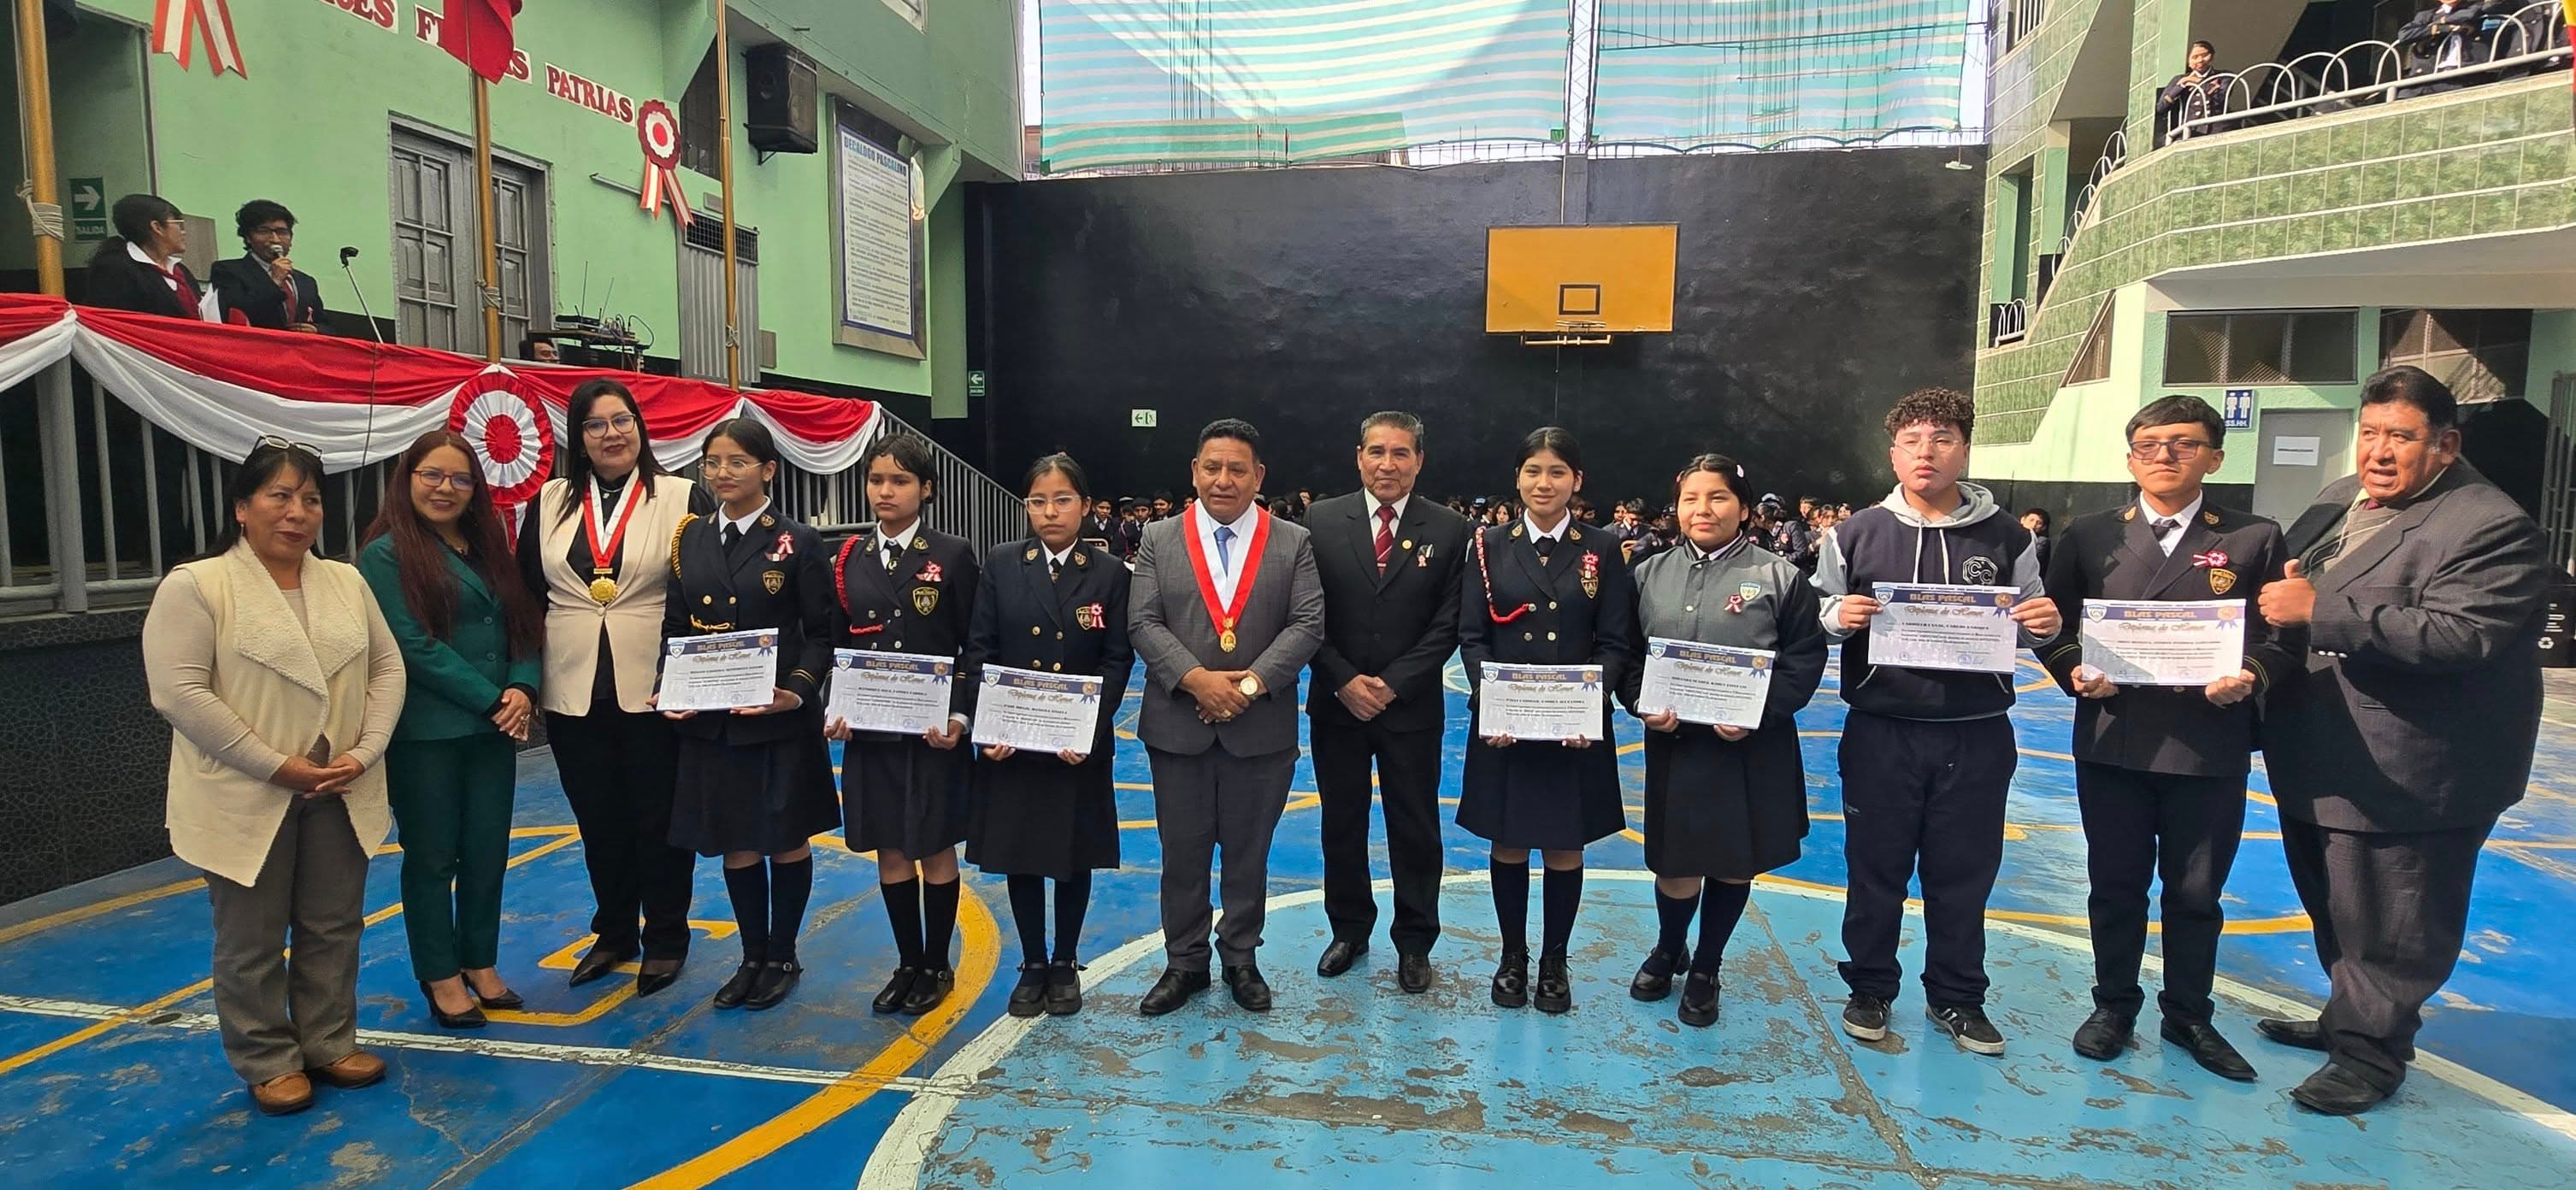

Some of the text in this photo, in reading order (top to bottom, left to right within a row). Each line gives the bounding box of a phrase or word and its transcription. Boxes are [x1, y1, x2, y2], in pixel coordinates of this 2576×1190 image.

[547, 65, 634, 122] PATRIAS
[1679, 650, 1737, 663] BLAS PASCAL
[889, 662, 919, 671] PASCAL
[1013, 678, 1069, 690] BLAS PASCAL
